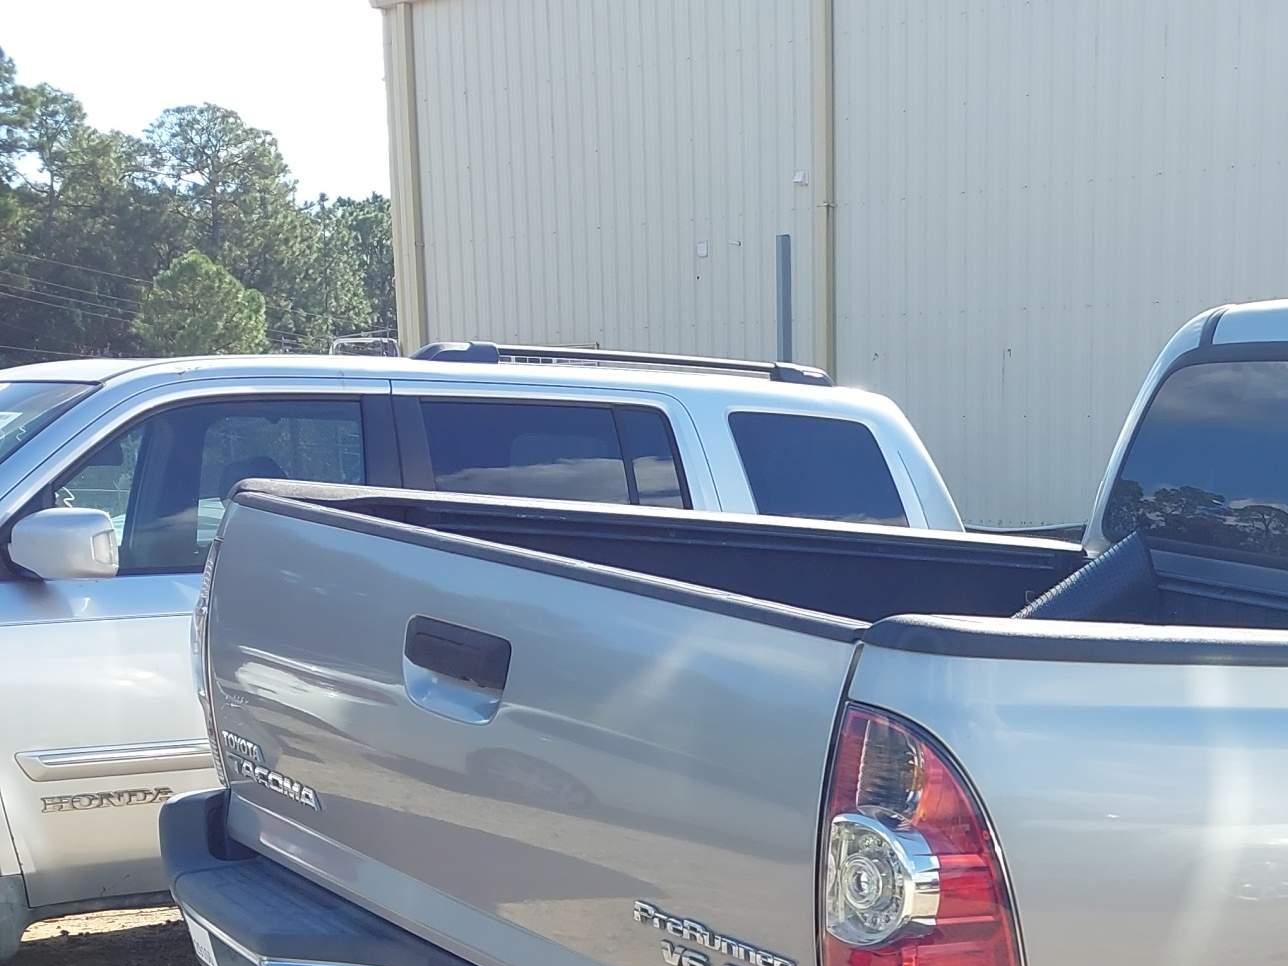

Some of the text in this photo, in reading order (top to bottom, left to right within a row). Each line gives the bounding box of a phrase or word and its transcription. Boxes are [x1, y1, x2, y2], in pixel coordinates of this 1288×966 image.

[221, 730, 265, 763] TOYOTA
[225, 751, 321, 811] TACOMA
[41, 787, 174, 813] HONDA
